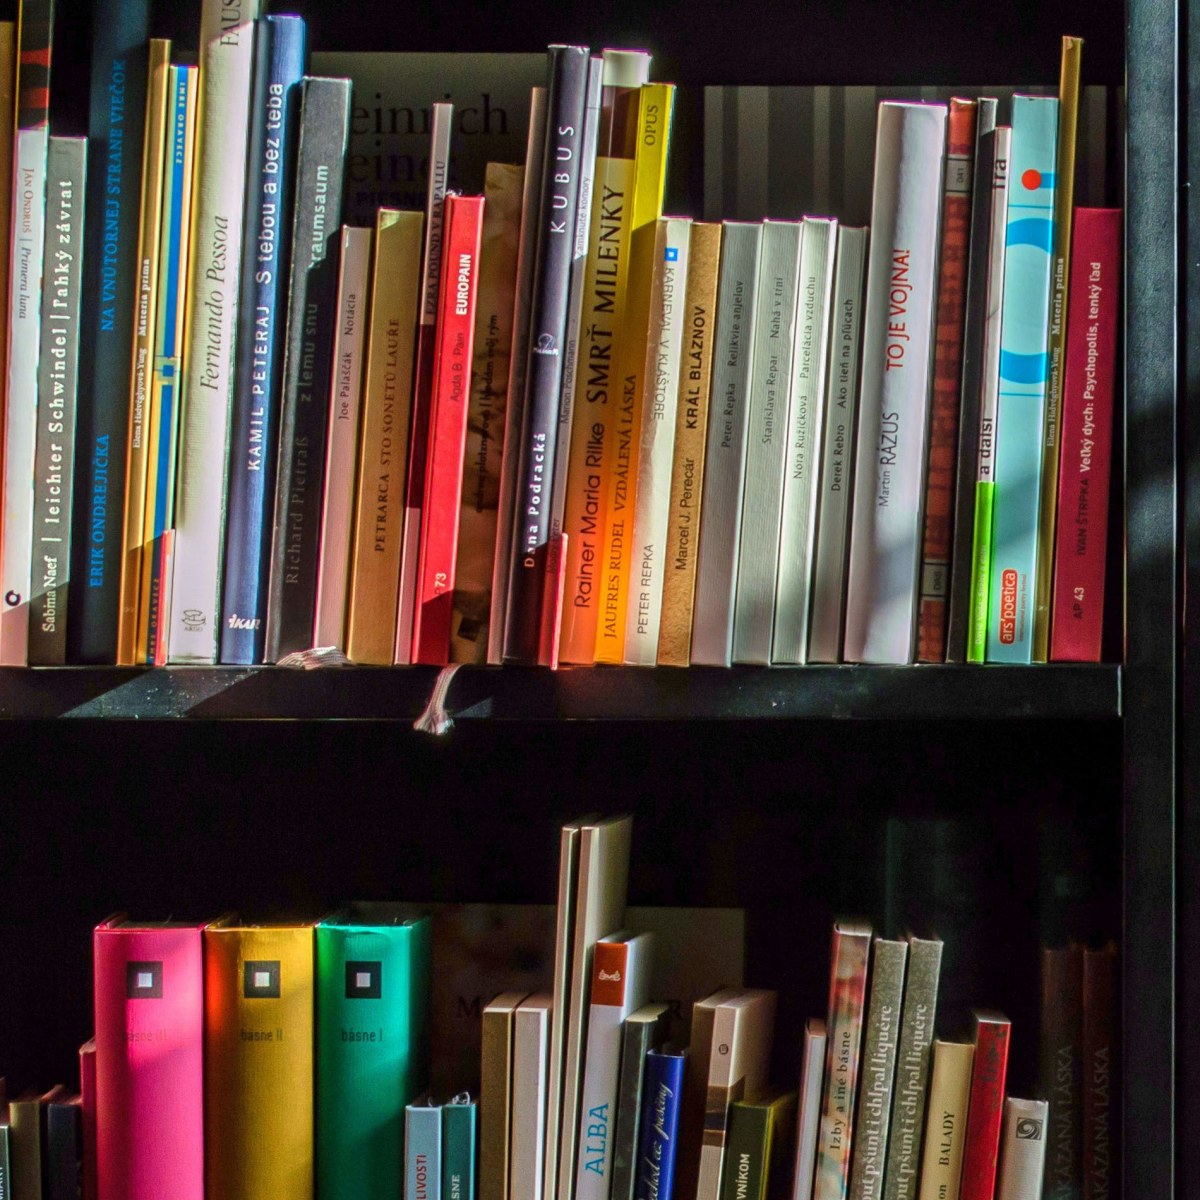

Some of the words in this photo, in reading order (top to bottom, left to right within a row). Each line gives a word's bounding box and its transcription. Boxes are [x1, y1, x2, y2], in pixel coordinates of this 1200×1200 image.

[265, 83, 283, 130] teba
[260, 137, 280, 175] bez
[551, 125, 575, 233] KUBUS
[55, 180, 72, 244] závrat
[265, 184, 278, 194] a
[205, 215, 229, 283] Pessoa
[257, 202, 277, 262] tebou
[594, 184, 624, 313] MILENKY
[256, 271, 272, 284] S
[455, 254, 472, 315] EUROPAIN
[888, 249, 912, 316] VOJNA!
[199, 289, 225, 390] Fernando
[252, 304, 271, 395] PETERAJ
[687, 305, 705, 380] BLÁZNOV
[886, 344, 904, 371] TO
[888, 321, 909, 340] JE
[46, 327, 67, 433] Schwindel
[585, 323, 613, 404] SMRŤ
[247, 406, 264, 471] KAMIL
[585, 423, 605, 467] Rilke
[44, 443, 63, 524] leichter
[527, 433, 547, 515] Podracká
[579, 474, 601, 530] Maria
[43, 556, 57, 587] Naef
[524, 525, 538, 567] Dana
[574, 541, 597, 608] Rainer
[41, 591, 56, 632] Sabina
[584, 1102, 609, 1175] ALBA
[938, 1111, 954, 1166] BALADY
